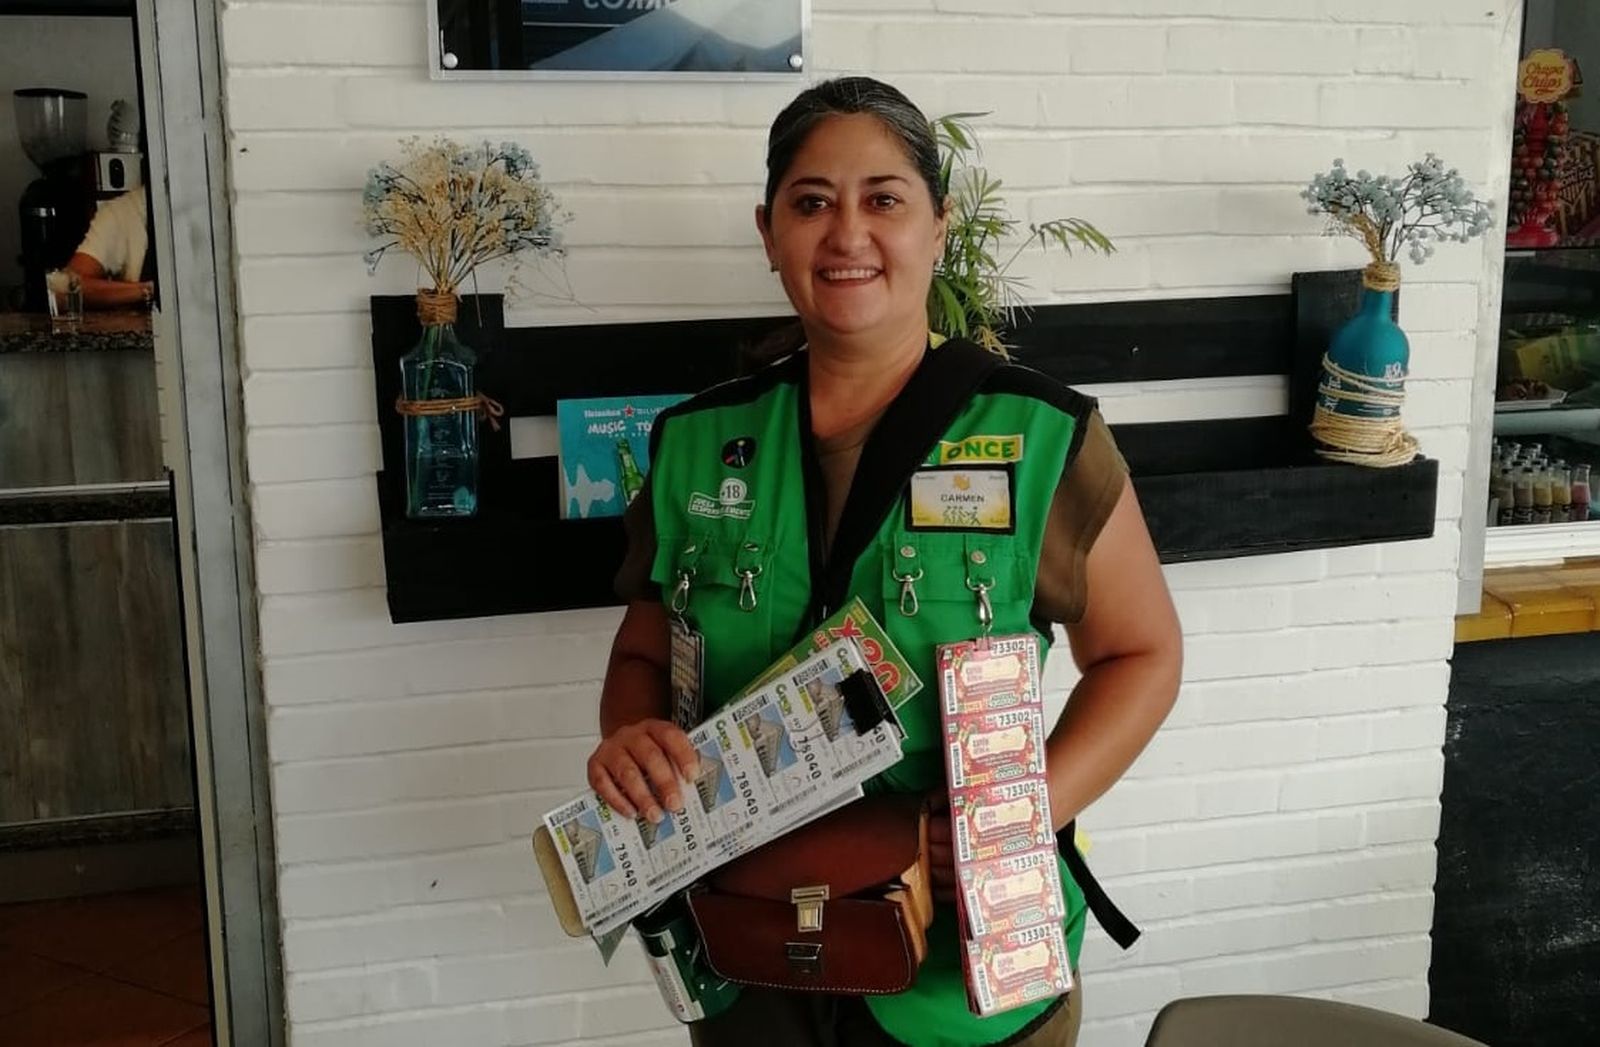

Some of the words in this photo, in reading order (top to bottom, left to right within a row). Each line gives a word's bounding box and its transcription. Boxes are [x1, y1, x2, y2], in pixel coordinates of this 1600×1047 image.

[1525, 62, 1564, 78] Chupa
[1522, 74, 1562, 89] Chups
[587, 420, 626, 435] MUSIC
[947, 441, 1016, 459] ONCE
[940, 494, 985, 503] CARMEN
[990, 640, 1025, 654] 73302
[998, 711, 1030, 726] 73302
[736, 771, 759, 816] 78040
[1005, 782, 1037, 797] 73302
[676, 807, 698, 851] 78040
[615, 842, 638, 887] 78040
[1014, 853, 1045, 869] 73302
[1021, 926, 1051, 943] 73302
